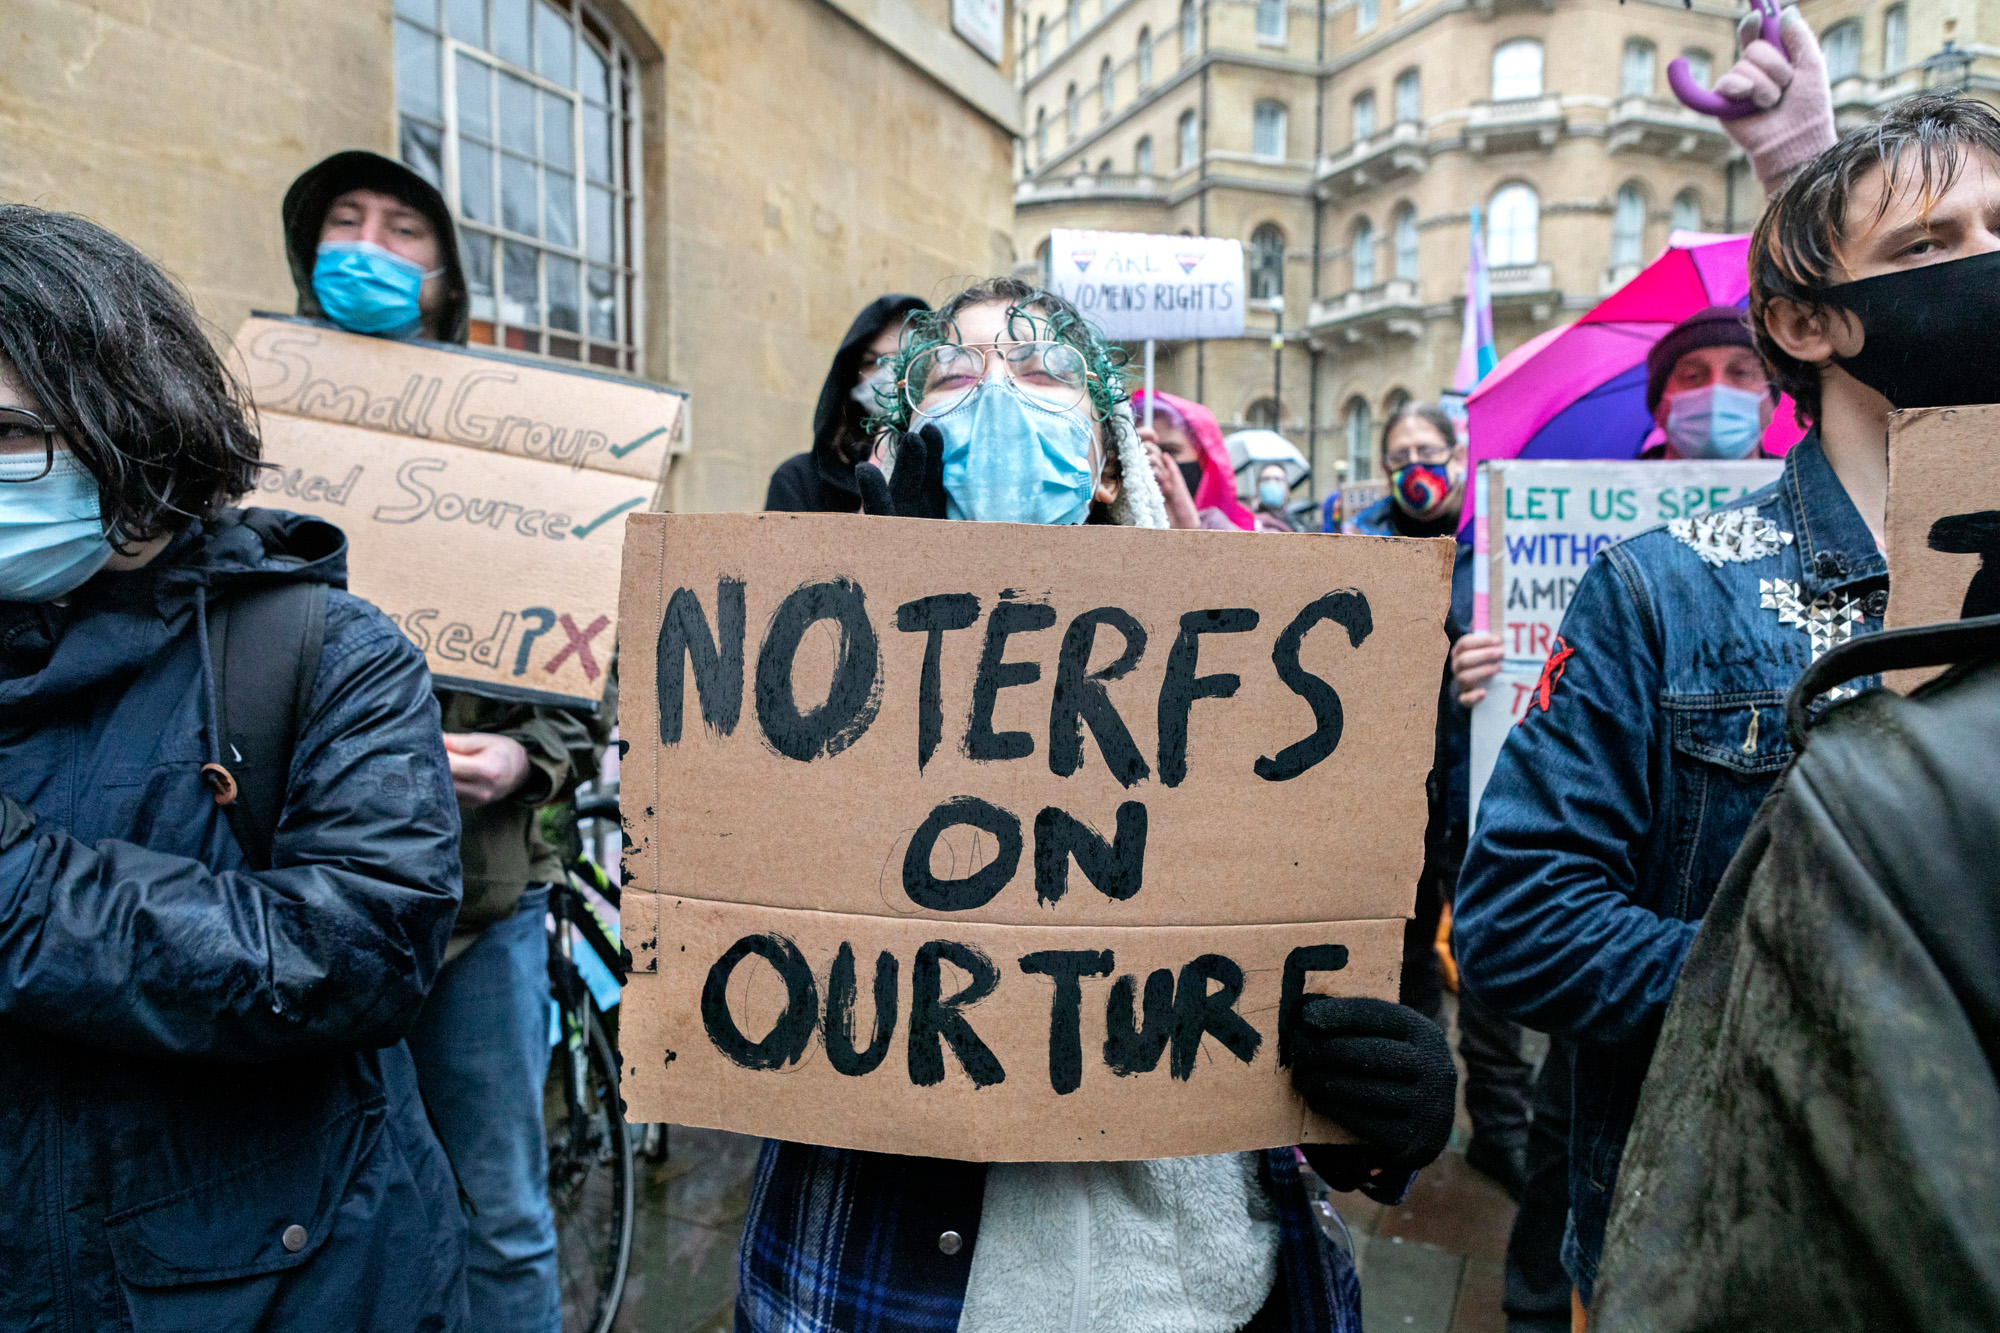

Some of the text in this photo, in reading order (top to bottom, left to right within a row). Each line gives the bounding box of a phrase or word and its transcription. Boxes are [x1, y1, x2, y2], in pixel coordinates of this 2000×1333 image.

[1153, 281, 1234, 312] RIGHTS
[247, 325, 608, 472] Small Group
[260, 458, 573, 541] oted Source
[1506, 485, 1751, 521] LET US SPE
[1505, 532, 1623, 566] WITH
[1507, 576, 1579, 611] AMP
[389, 606, 557, 677] sed?
[1507, 622, 1551, 655] TR
[657, 573, 1374, 790] NO TERFS
[900, 796, 1148, 911] ON
[700, 931, 1349, 1095] OUR TURF
